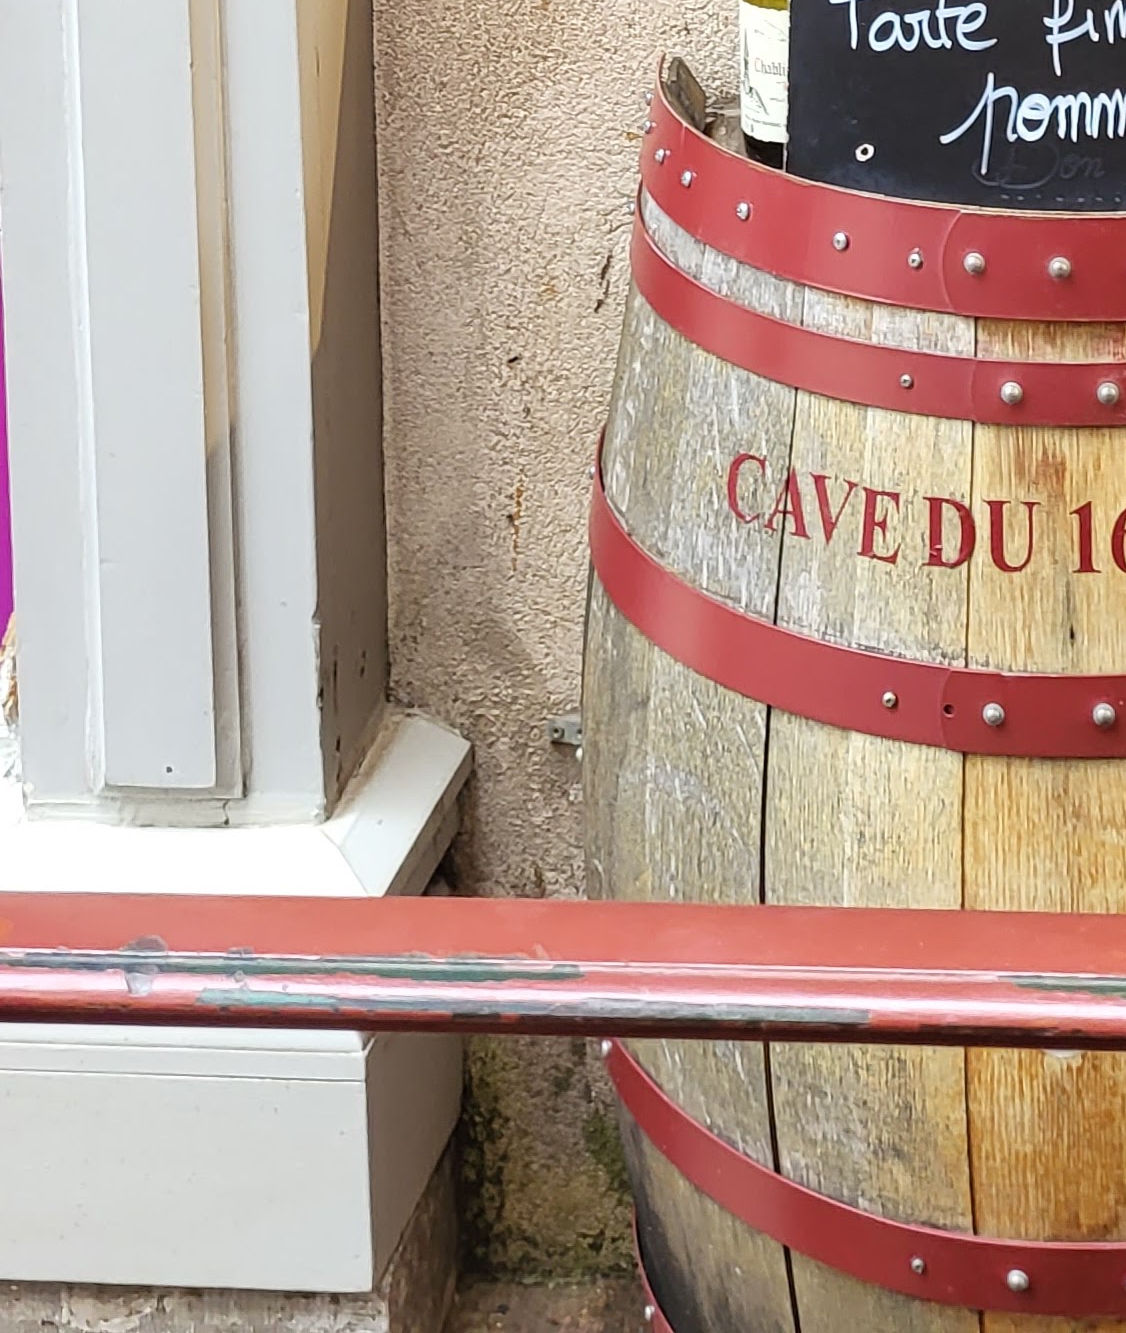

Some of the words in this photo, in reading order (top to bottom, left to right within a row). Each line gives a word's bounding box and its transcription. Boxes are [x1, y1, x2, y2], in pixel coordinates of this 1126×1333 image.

[755, 58, 789, 76] Chabli
[726, 452, 900, 566] CAVE
[923, 497, 1040, 573] DU
